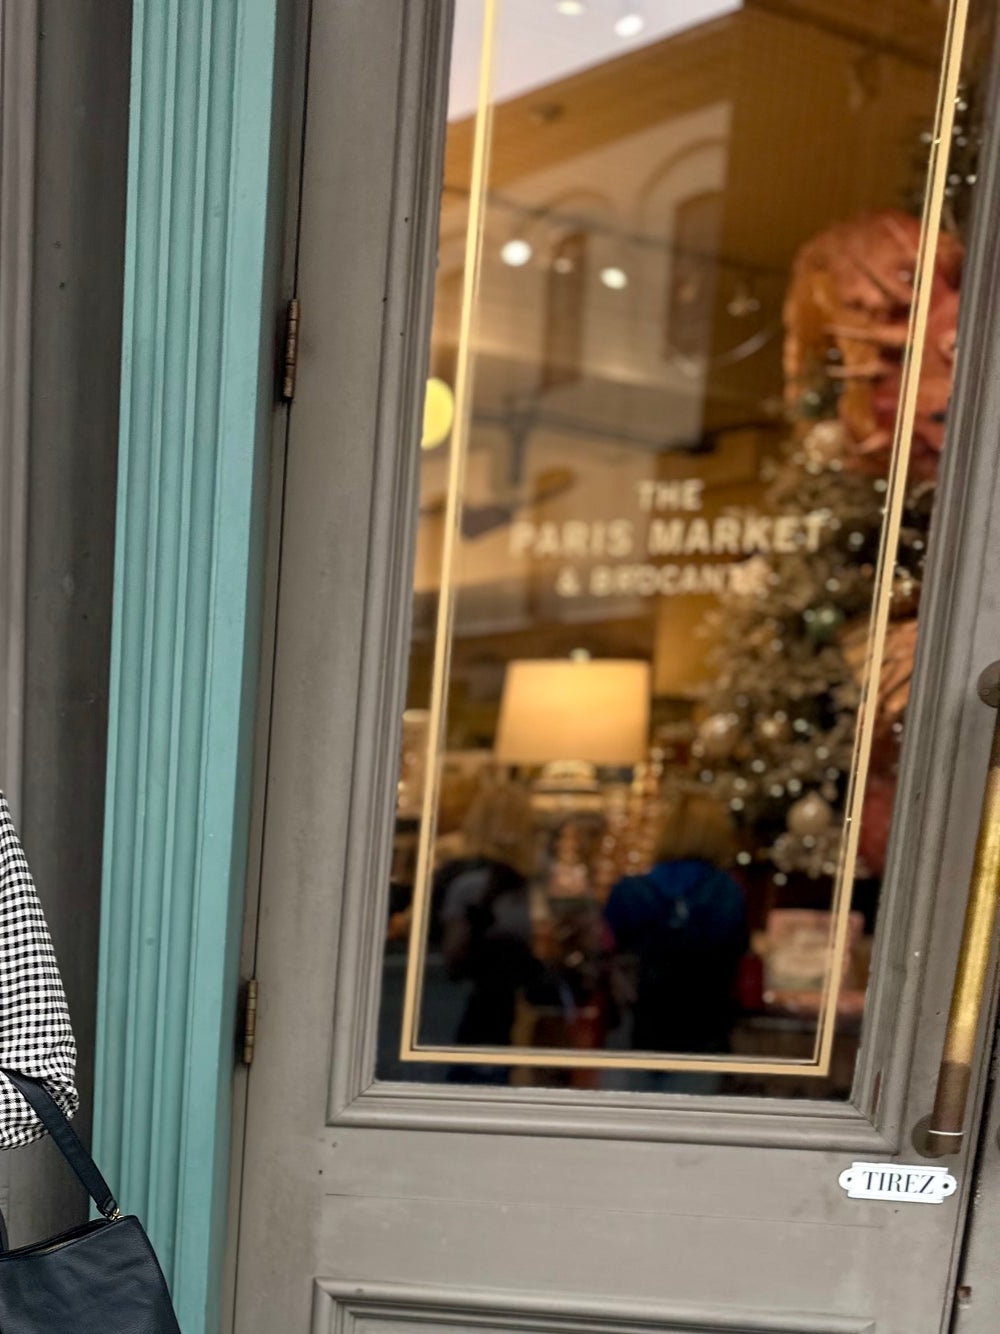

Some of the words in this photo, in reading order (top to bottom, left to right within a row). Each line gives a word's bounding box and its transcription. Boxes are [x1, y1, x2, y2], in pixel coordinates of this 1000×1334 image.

[637, 479, 703, 511] THE
[509, 519, 634, 557] PARIS
[648, 515, 824, 556] MARKET
[556, 565, 581, 597] &
[862, 1171, 936, 1195] TIREZ
